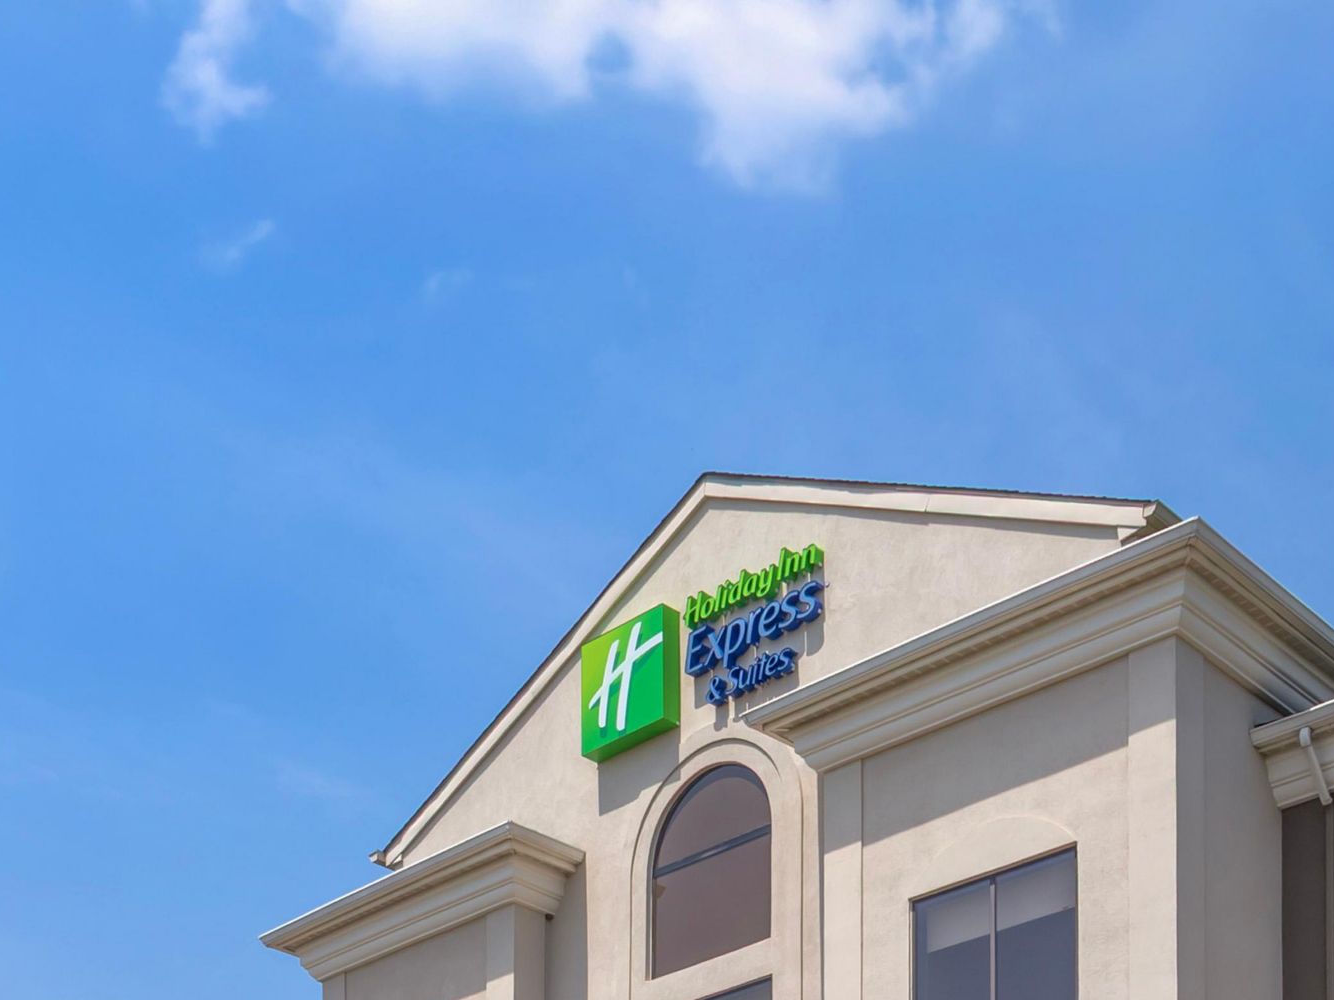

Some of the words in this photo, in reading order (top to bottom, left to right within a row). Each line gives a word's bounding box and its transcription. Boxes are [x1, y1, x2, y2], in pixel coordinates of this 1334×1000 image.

[684, 564, 779, 629] Holiday
[776, 543, 824, 581] Inn
[685, 580, 824, 676] Express
[588, 621, 663, 732] H
[706, 674, 729, 706] &
[726, 648, 798, 698] Suites
